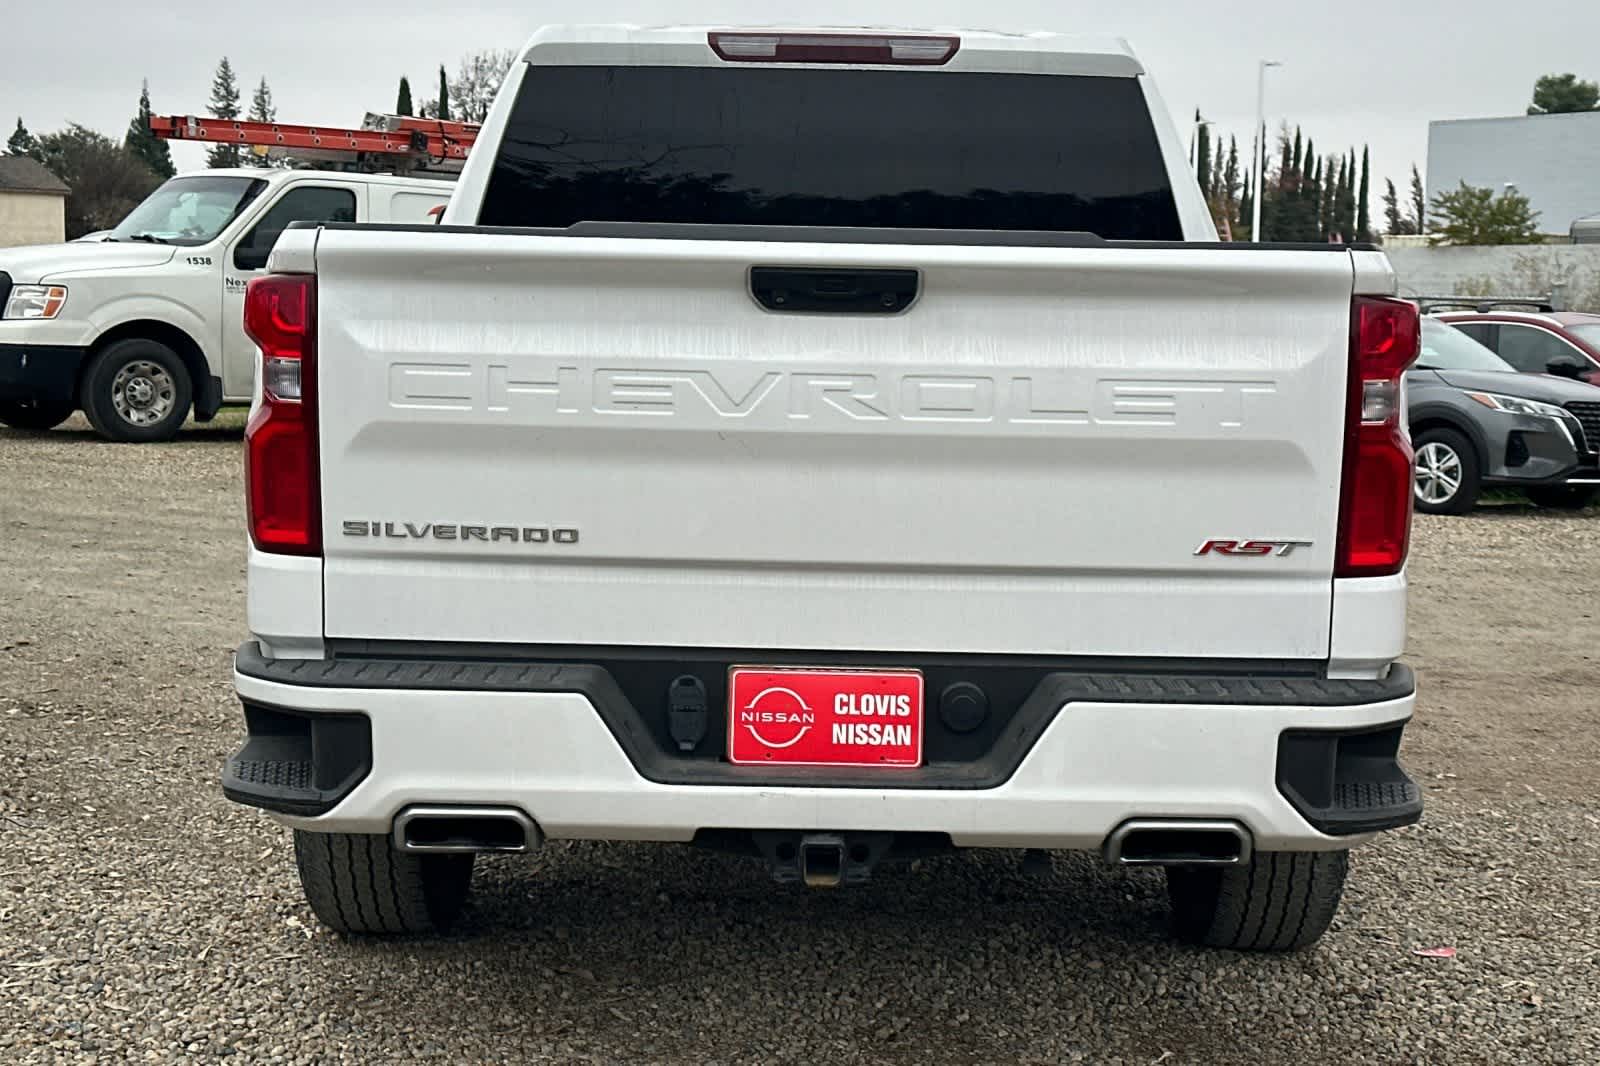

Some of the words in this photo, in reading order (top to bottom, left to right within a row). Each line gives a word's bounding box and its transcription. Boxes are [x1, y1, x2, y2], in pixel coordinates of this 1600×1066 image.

[186, 257, 212, 265] 1538
[389, 362, 1277, 428] CHEVROLET
[343, 520, 579, 544] SILVERADO
[1193, 539, 1313, 557] RST
[834, 693, 911, 717] CLOVIS
[741, 711, 815, 724] NISSAN
[831, 723, 912, 746] NISSAN
